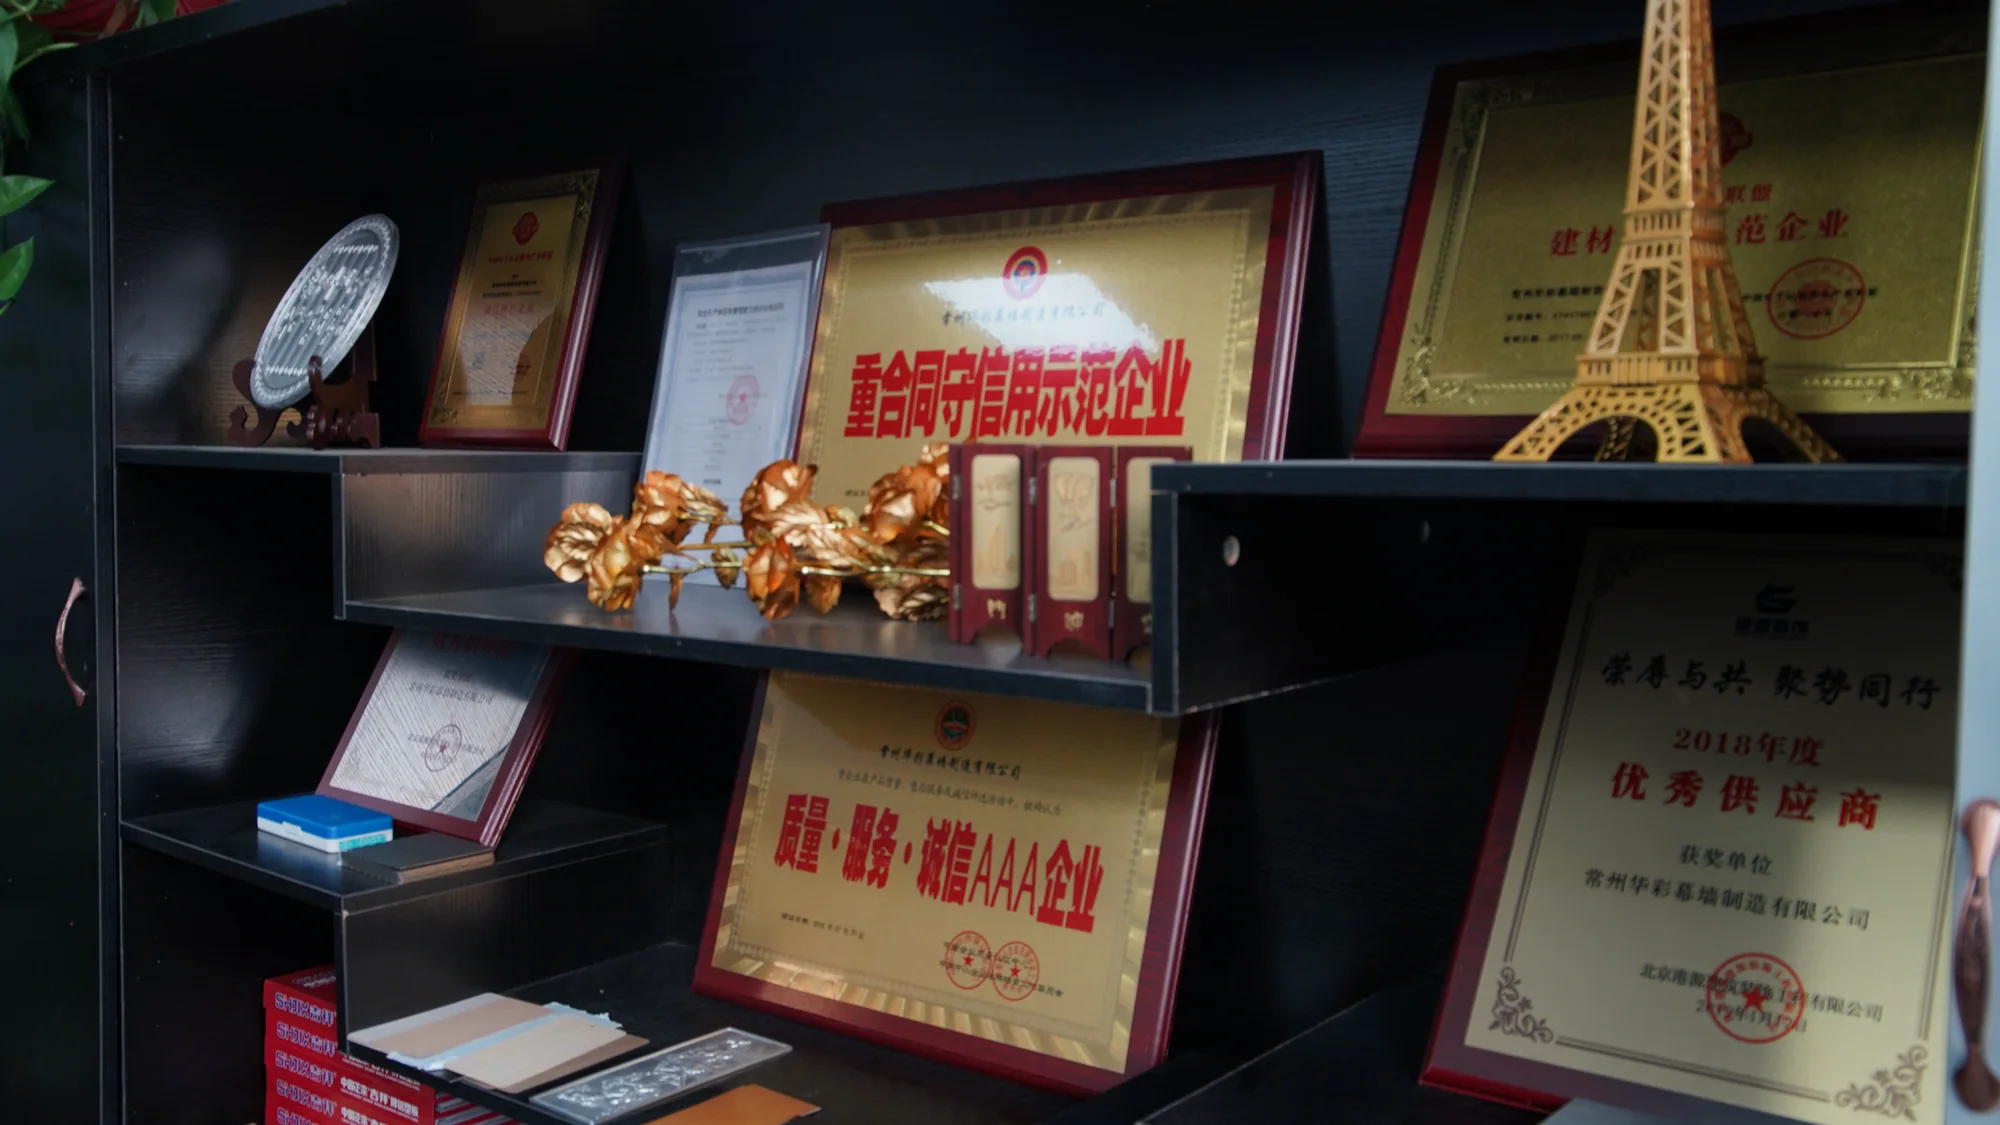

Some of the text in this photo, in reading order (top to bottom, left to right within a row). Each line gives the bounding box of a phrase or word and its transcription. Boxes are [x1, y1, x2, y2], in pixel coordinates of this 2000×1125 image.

[844, 338, 1193, 439] 重合同守信用示范企业
[1602, 652, 1942, 710] 荣辱与共 聚势同行
[1672, 727, 1825, 768] 2018年度
[1611, 761, 1882, 831] 优秀供应商
[1680, 843, 1774, 877] 获奖单位
[1584, 866, 1871, 932] 常州华彩幕墙制造有限公司
